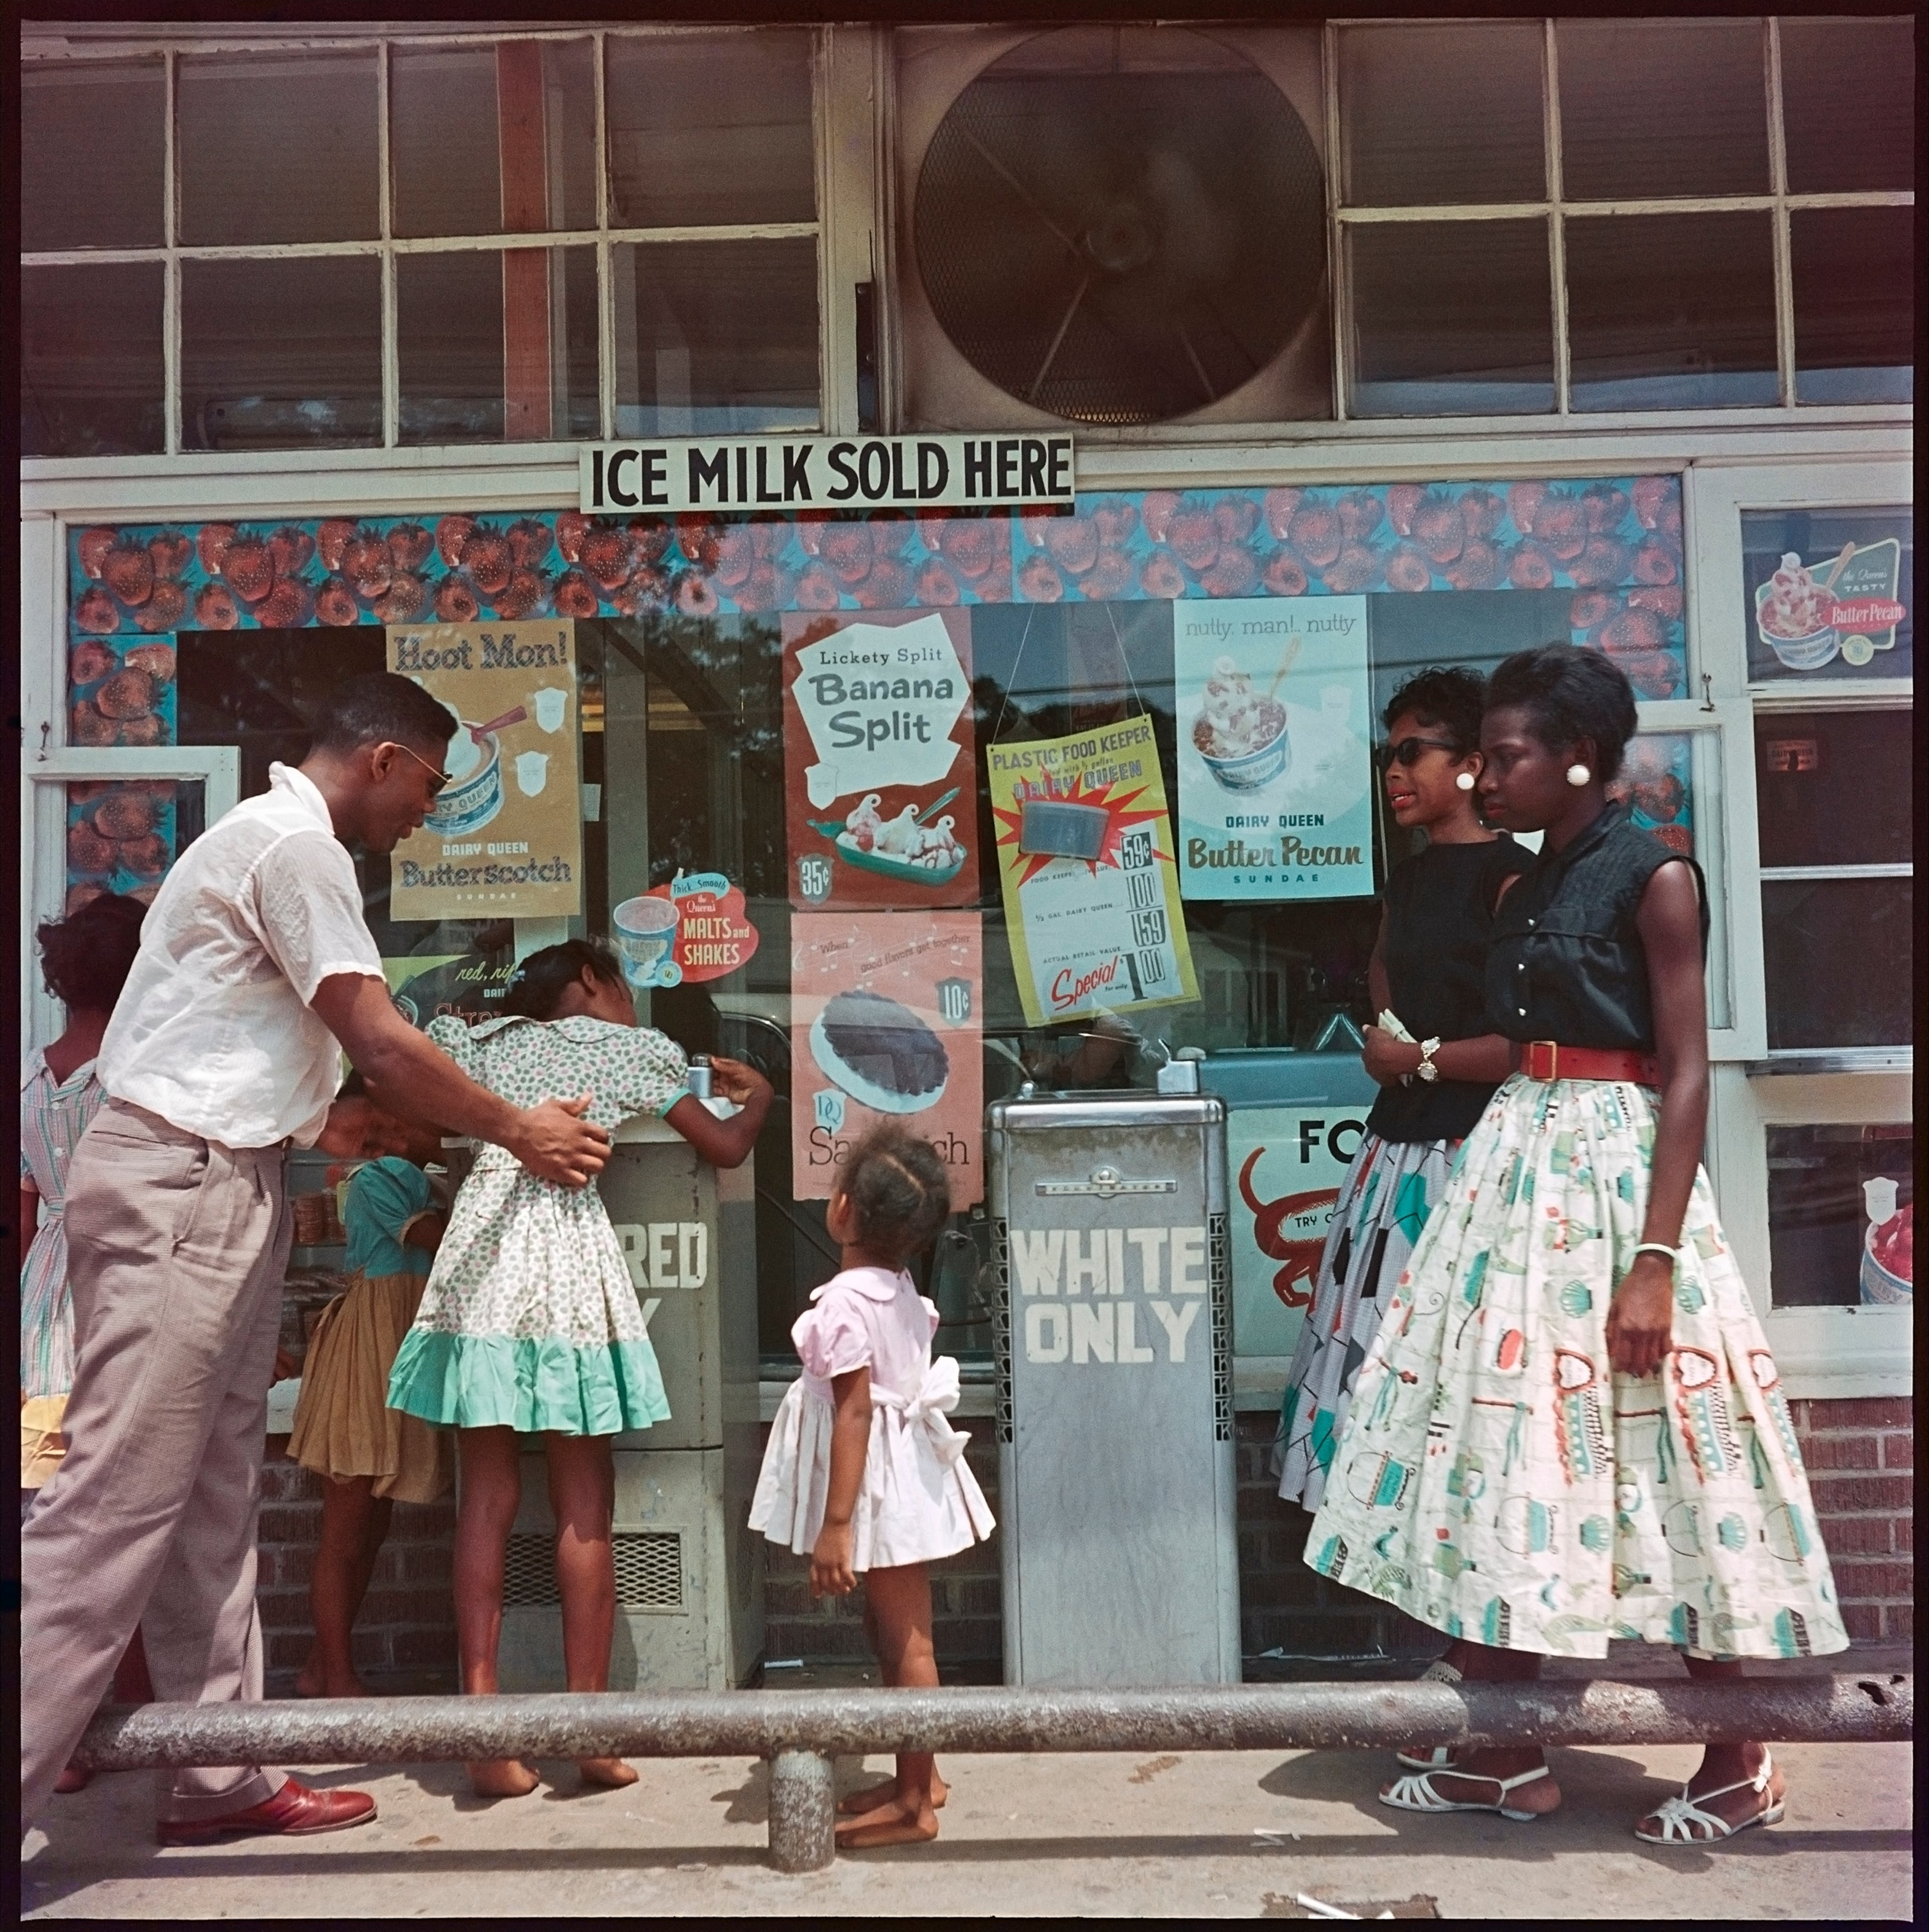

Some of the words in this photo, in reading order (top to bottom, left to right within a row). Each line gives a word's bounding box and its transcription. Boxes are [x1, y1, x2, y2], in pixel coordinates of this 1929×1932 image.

[592, 450, 668, 506] ICE
[688, 445, 813, 503] MILK
[827, 441, 949, 501] SOLD
[964, 439, 1072, 497] HERE
[1844, 583, 1886, 592] TASTY
[1307, 613, 1357, 635] nutty
[1832, 606, 1869, 624] Butter
[1869, 603, 1902, 621] Pecan
[394, 635, 473, 671] Hoot
[480, 631, 567, 669] Mon!
[820, 651, 890, 666] Lickety
[898, 648, 942, 662] Split
[808, 673, 953, 705] Banana
[829, 711, 931, 750] Split
[993, 748, 1057, 771] PLASTIC
[1062, 740, 1097, 763] FOOD
[1100, 725, 1151, 754] KEEPER
[1092, 757, 1114, 770] gallon
[1014, 775, 1075, 800] DAIRY
[1084, 759, 1143, 789] QUEEN
[1226, 816, 1269, 828] DAIRY
[1279, 814, 1325, 829] QUEEN
[442, 843, 482, 856] DAIRY
[487, 842, 528, 856] QUEEN
[1031, 876, 1049, 884] FOOD
[1123, 834, 1150, 870] 59¢
[1188, 838, 1277, 869] Butter
[1281, 835, 1364, 866] Pecan
[400, 856, 572, 888] Butterscotch
[802, 860, 829, 895] 35¢
[1234, 874, 1319, 883] SUNDAE
[697, 879, 726, 890] Smooth
[456, 892, 516, 900] SUNDAE
[686, 900, 716, 913] Queen's
[698, 894, 706, 903] the
[1048, 911, 1061, 919] GAL
[1066, 907, 1087, 916] DAIRY
[1091, 903, 1113, 912] QUEEN
[683, 917, 732, 939] MALTS
[732, 926, 749, 938] and
[684, 943, 740, 965] SHAKES
[820, 942, 848, 953] When
[861, 960, 883, 973] good
[885, 948, 913, 964] flavors
[916, 942, 930, 954] get
[933, 934, 970, 948] together
[1043, 955, 1069, 963] ACTUAL
[1073, 951, 1095, 959] RETAIL
[1100, 946, 1121, 955] VALUE
[455, 960, 487, 981] red,
[1051, 955, 1118, 1010] Special
[944, 985, 969, 1019] 10¢
[1295, 1216, 1317, 1228] TRY
[1010, 1227, 1207, 1296] WHITE
[1025, 1301, 1202, 1363] ONLY
